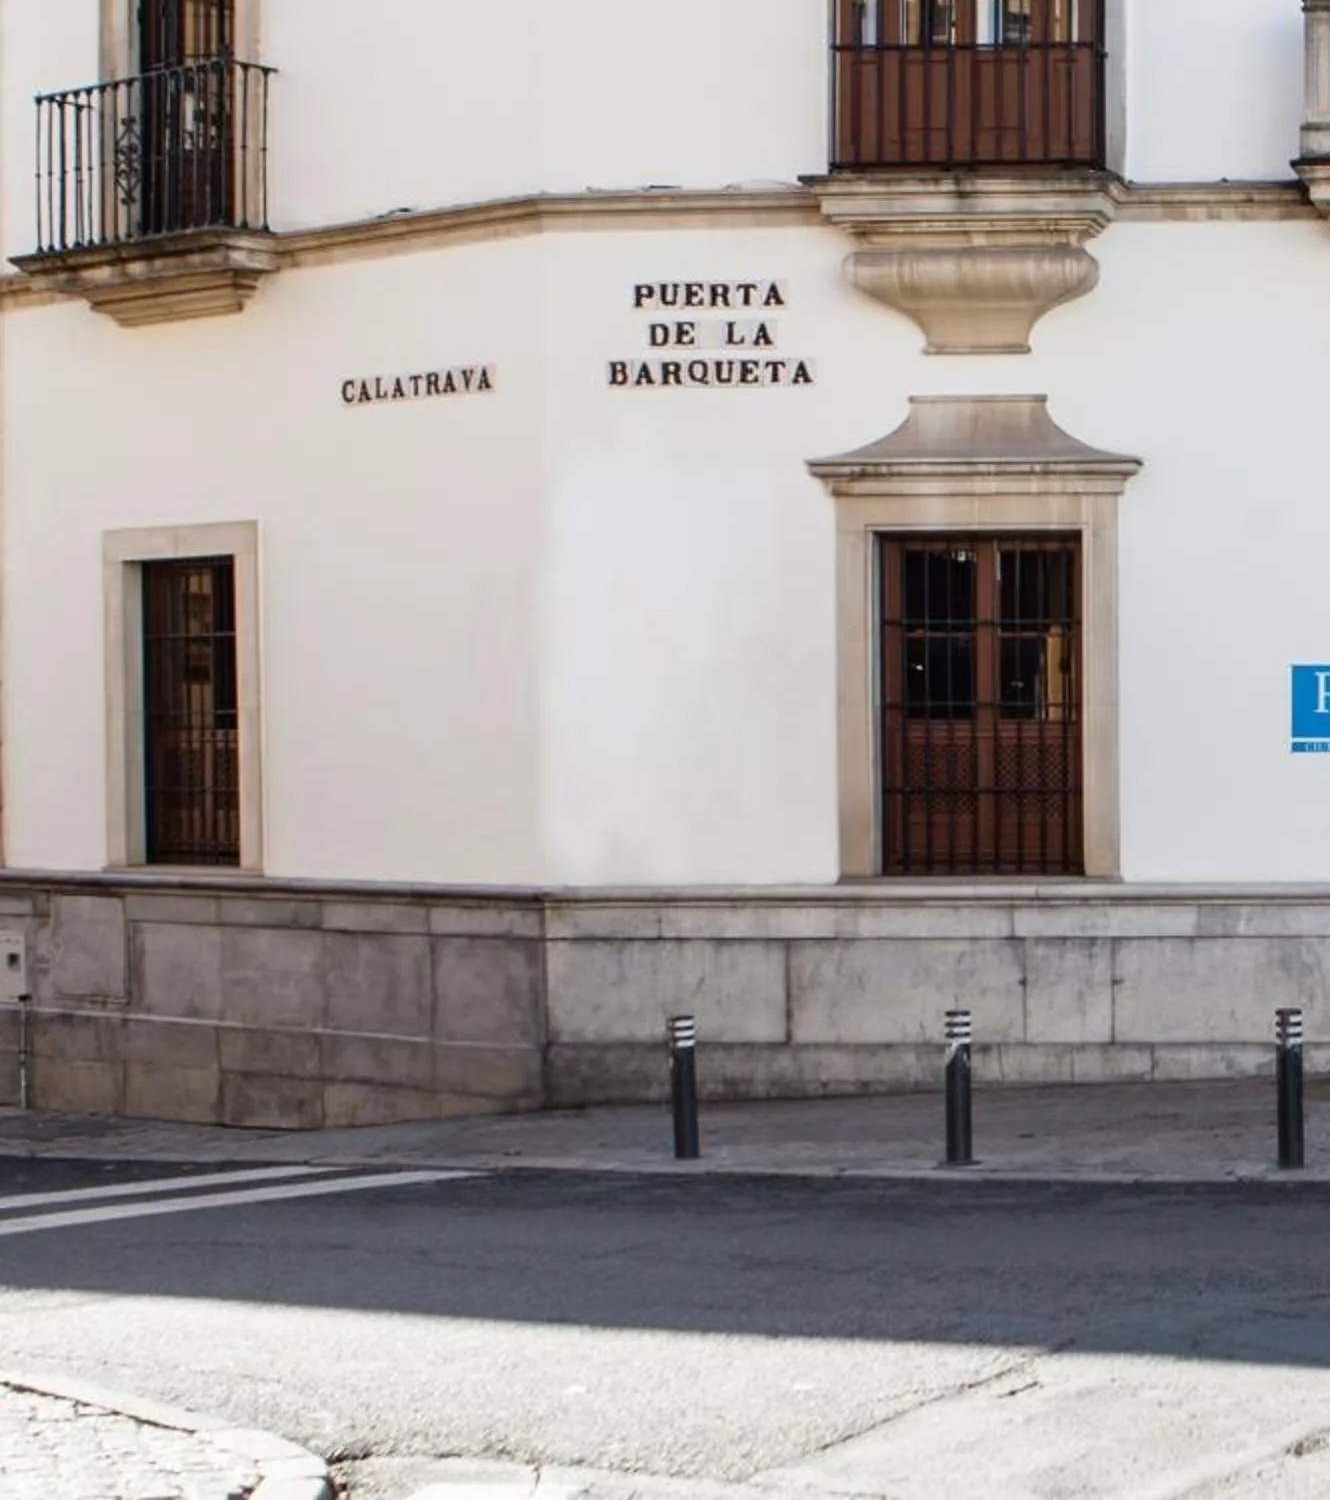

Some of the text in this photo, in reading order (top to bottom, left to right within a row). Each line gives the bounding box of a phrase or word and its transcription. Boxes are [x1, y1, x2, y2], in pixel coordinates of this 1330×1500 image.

[634, 282, 785, 308] PUERTA
[649, 321, 774, 347] DE LA
[341, 367, 493, 404] CALATRAVA
[608, 359, 813, 386] BARQUETA
